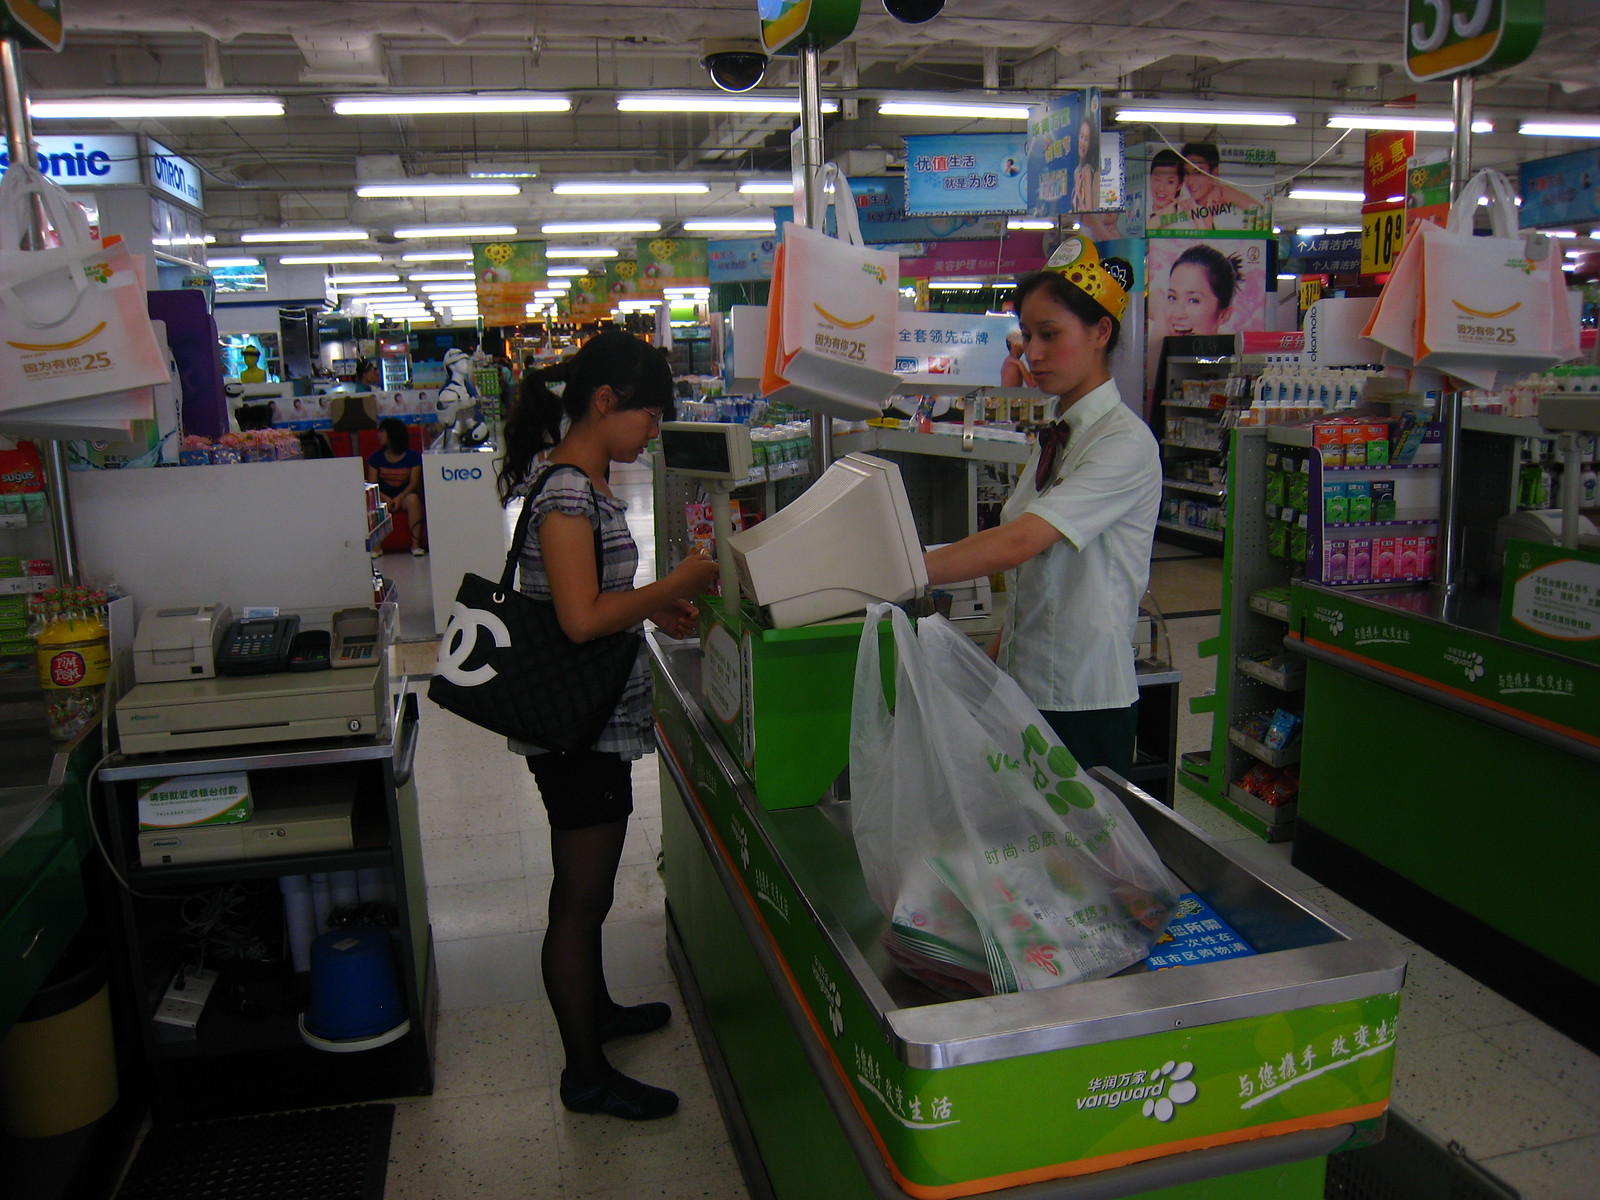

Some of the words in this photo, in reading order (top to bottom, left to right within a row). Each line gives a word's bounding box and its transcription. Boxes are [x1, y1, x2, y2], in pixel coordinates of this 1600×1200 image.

[914, 154, 977, 172] 优值生活
[1368, 138, 1407, 176] 特惠
[944, 173, 999, 190] 就是为您
[934, 259, 977, 271] 美容护理
[978, 259, 995, 268] Skin
[898, 328, 989, 345] 全套领先品牌
[1307, 306, 1317, 362] okamoto
[2, 471, 35, 483] sugus
[442, 466, 482, 480] breo
[1169, 932, 1235, 948] 一次性在
[1149, 942, 1248, 966] 超市区购物满
[1087, 1069, 1148, 1093] 华润万家
[1076, 1078, 1167, 1111] vanguard
